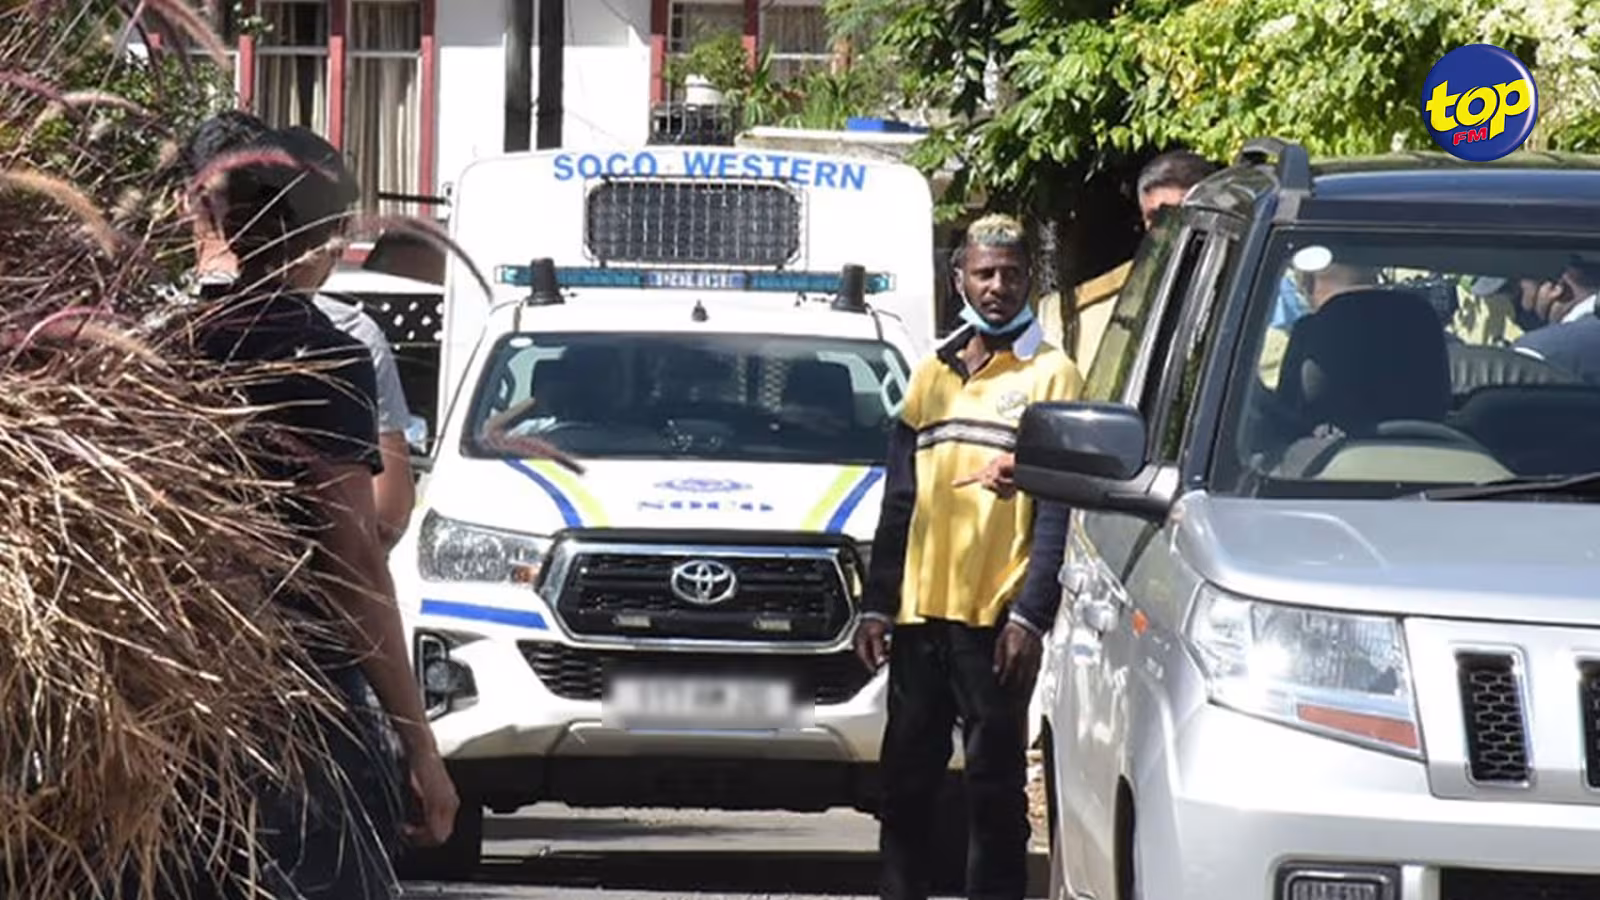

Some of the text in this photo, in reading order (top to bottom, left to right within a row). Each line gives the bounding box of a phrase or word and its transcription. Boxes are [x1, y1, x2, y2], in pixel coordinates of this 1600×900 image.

[553, 151, 866, 190] SOCO WESTERN
[655, 272, 731, 288] POLICE
